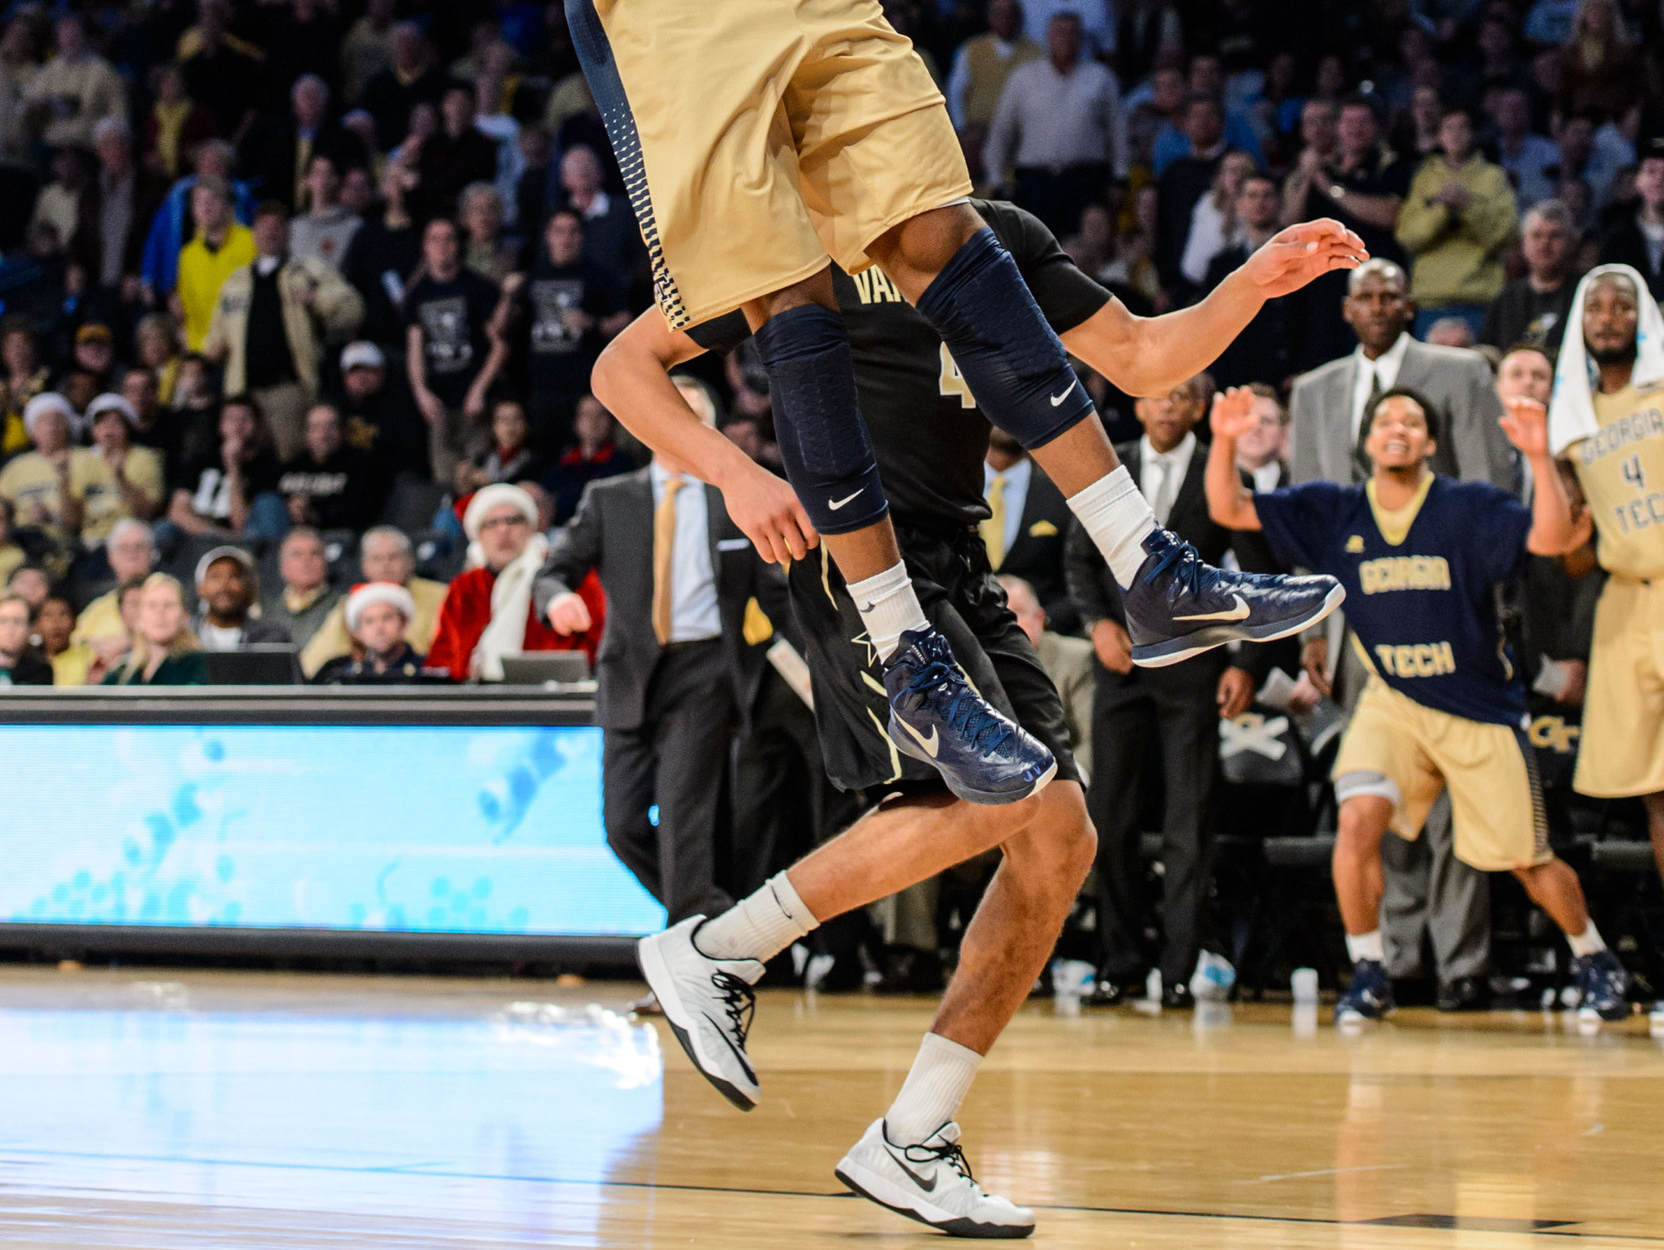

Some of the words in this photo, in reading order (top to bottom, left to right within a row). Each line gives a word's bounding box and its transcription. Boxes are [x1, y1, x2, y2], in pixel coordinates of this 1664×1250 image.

[1581, 407, 1664, 467] GEORGIA
[1621, 451, 1645, 490] 4
[1374, 640, 1456, 678] TECH
